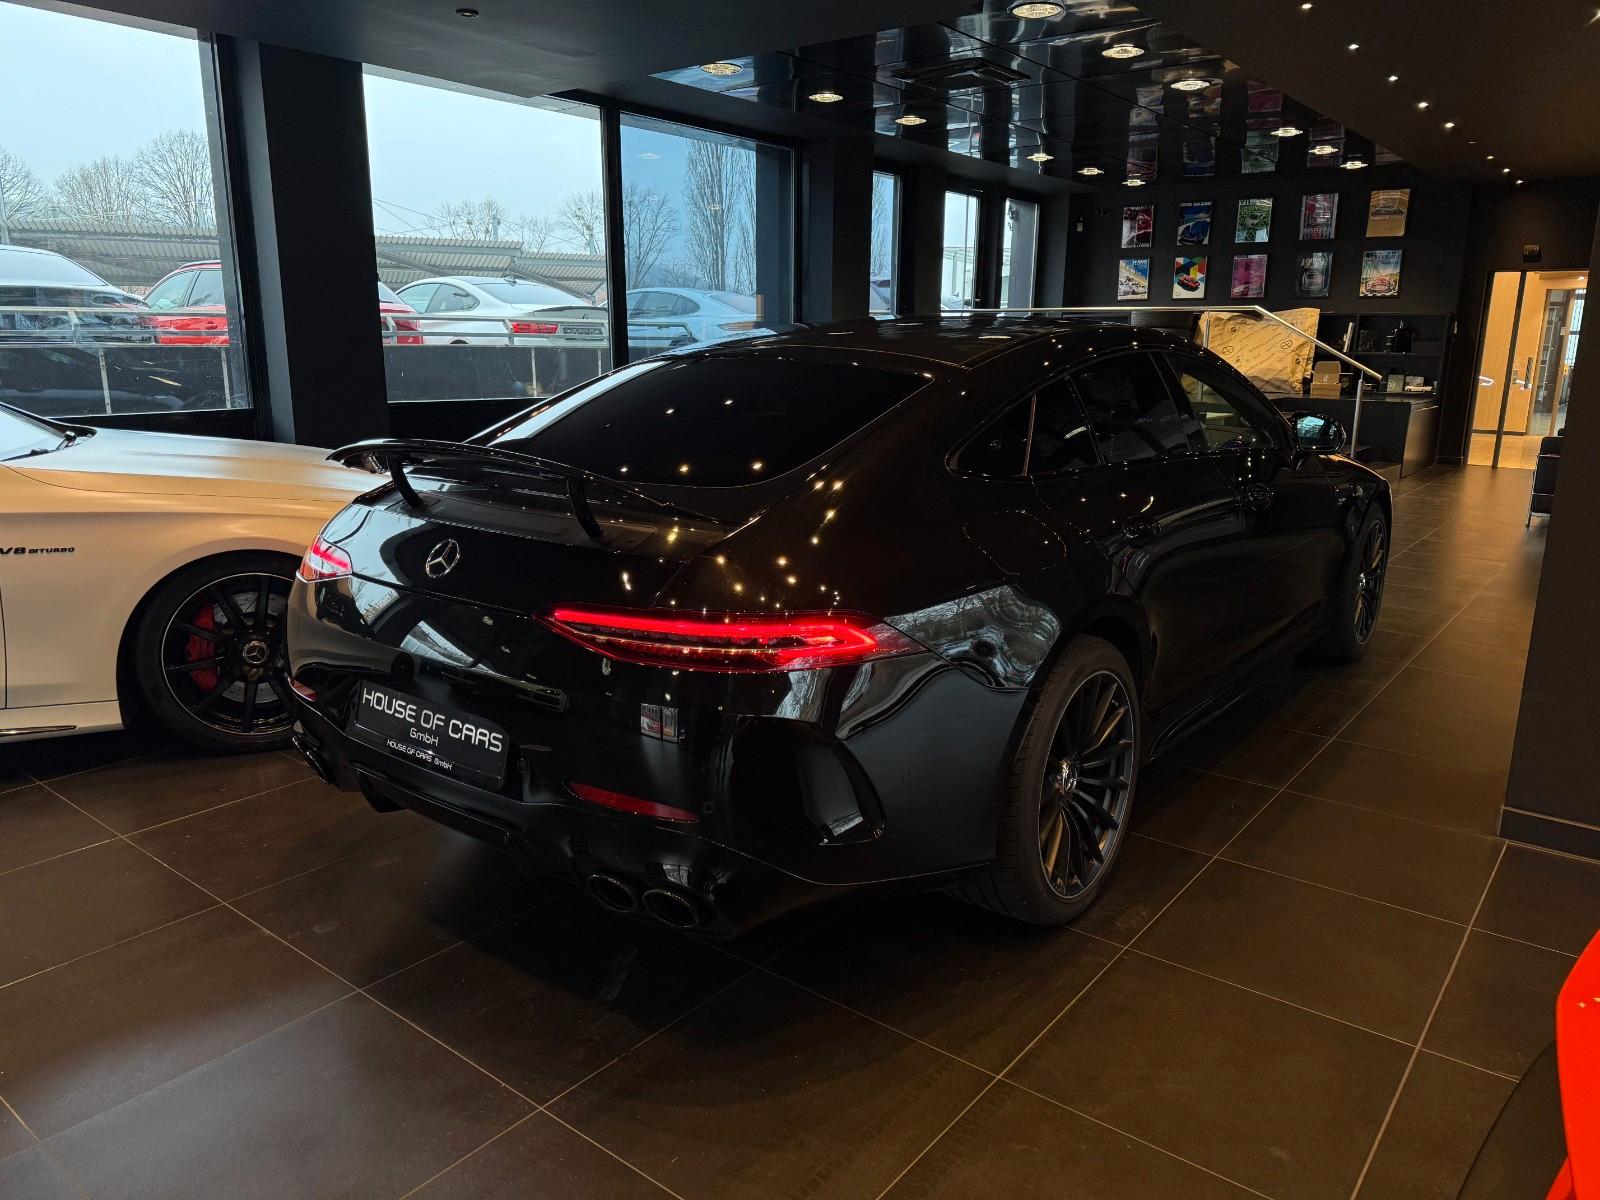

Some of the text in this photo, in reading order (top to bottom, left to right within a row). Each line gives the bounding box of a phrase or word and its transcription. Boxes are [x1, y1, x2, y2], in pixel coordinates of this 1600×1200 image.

[362, 688, 503, 753] HOUSE OF CARS
[409, 727, 439, 747] GmbH
[386, 739, 453, 771] HOUSE OF CARS GmbH
